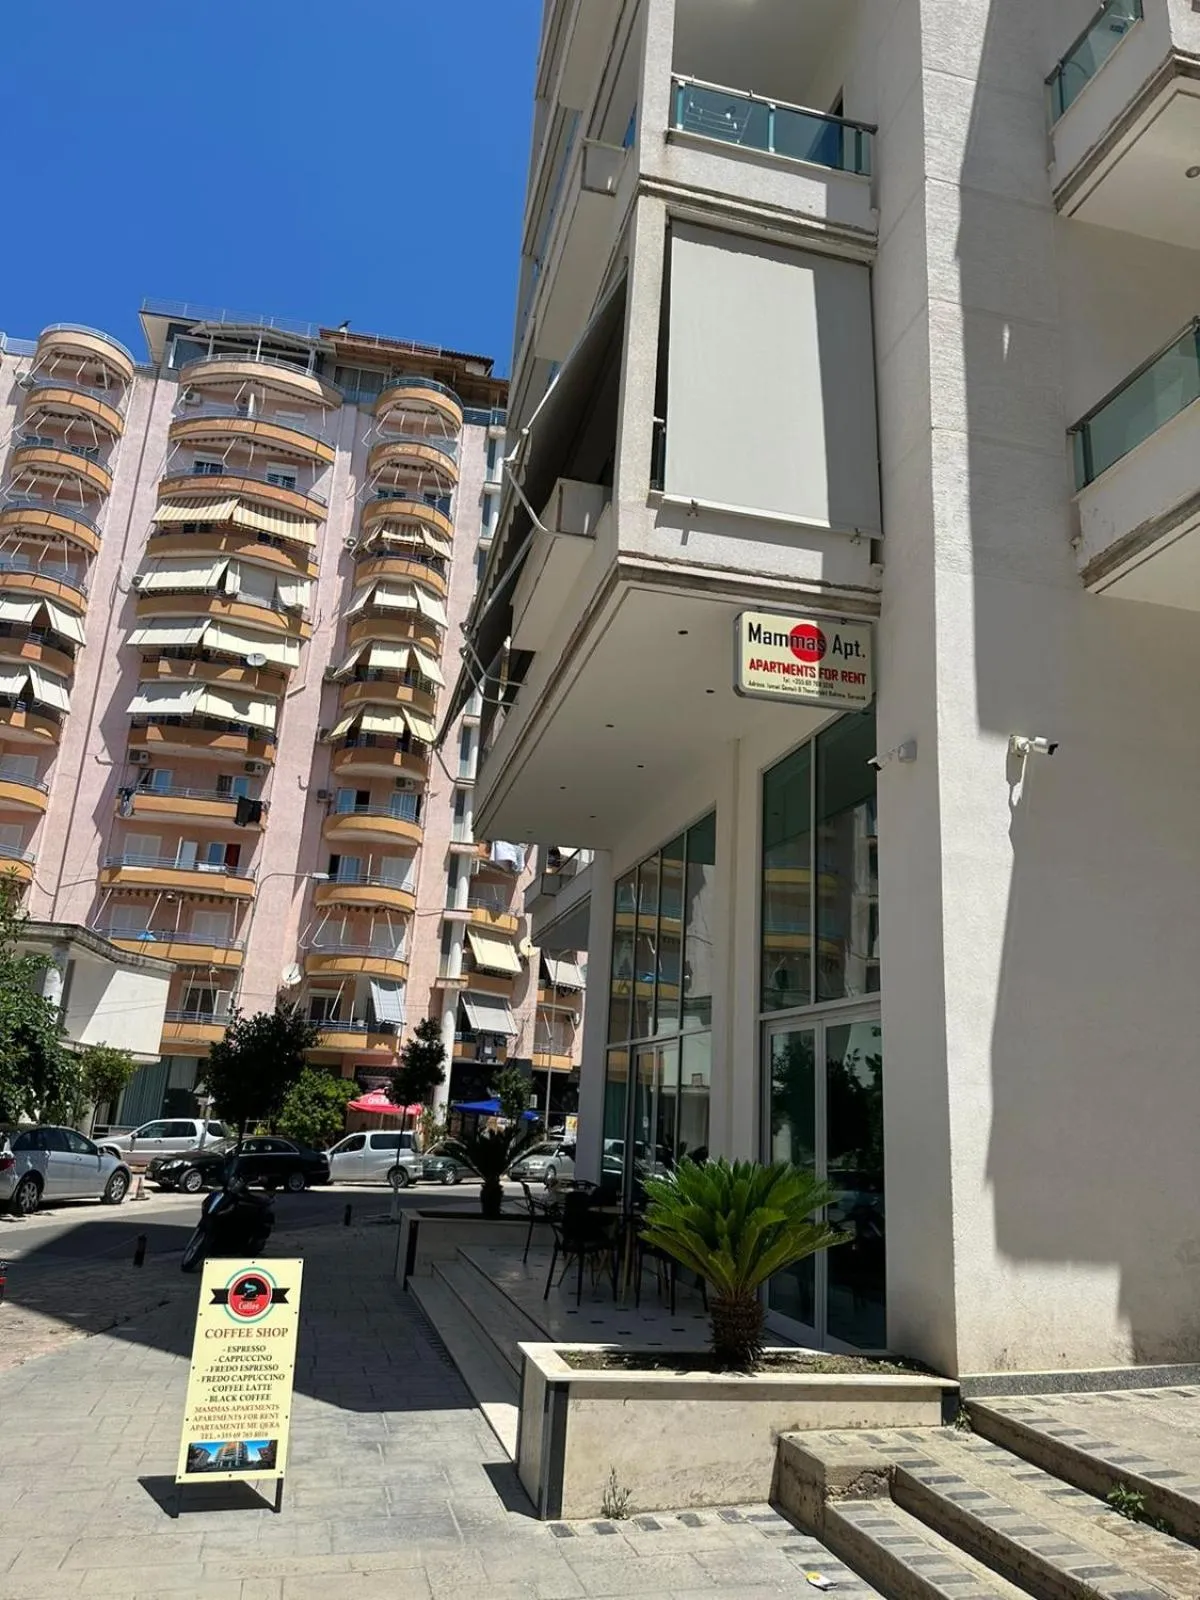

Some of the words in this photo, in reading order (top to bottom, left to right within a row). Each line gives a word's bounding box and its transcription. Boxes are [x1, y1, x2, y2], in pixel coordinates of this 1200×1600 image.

[748, 622, 827, 652] Mammas
[832, 634, 866, 660] Apt.
[749, 658, 817, 678] APARTMENTS
[818, 667, 838, 681] FOR
[841, 670, 867, 685] RENT
[205, 1328, 253, 1339] COFFEE
[256, 1327, 289, 1338] SHOP
[227, 1345, 267, 1353] ESPRESSO
[240, 1364, 279, 1372] ESPRESSO
[201, 1375, 230, 1383] FREDO
[231, 1374, 285, 1382] CAPPUCCINO
[212, 1384, 245, 1392] COFFEE
[246, 1383, 273, 1391] LATTE
[210, 1395, 237, 1403] BLACK
[239, 1393, 272, 1401] COFFEE
[194, 1405, 230, 1413] MAMMAS
[193, 1414, 242, 1422] APARTMENTS
[259, 1412, 279, 1420] RENT
